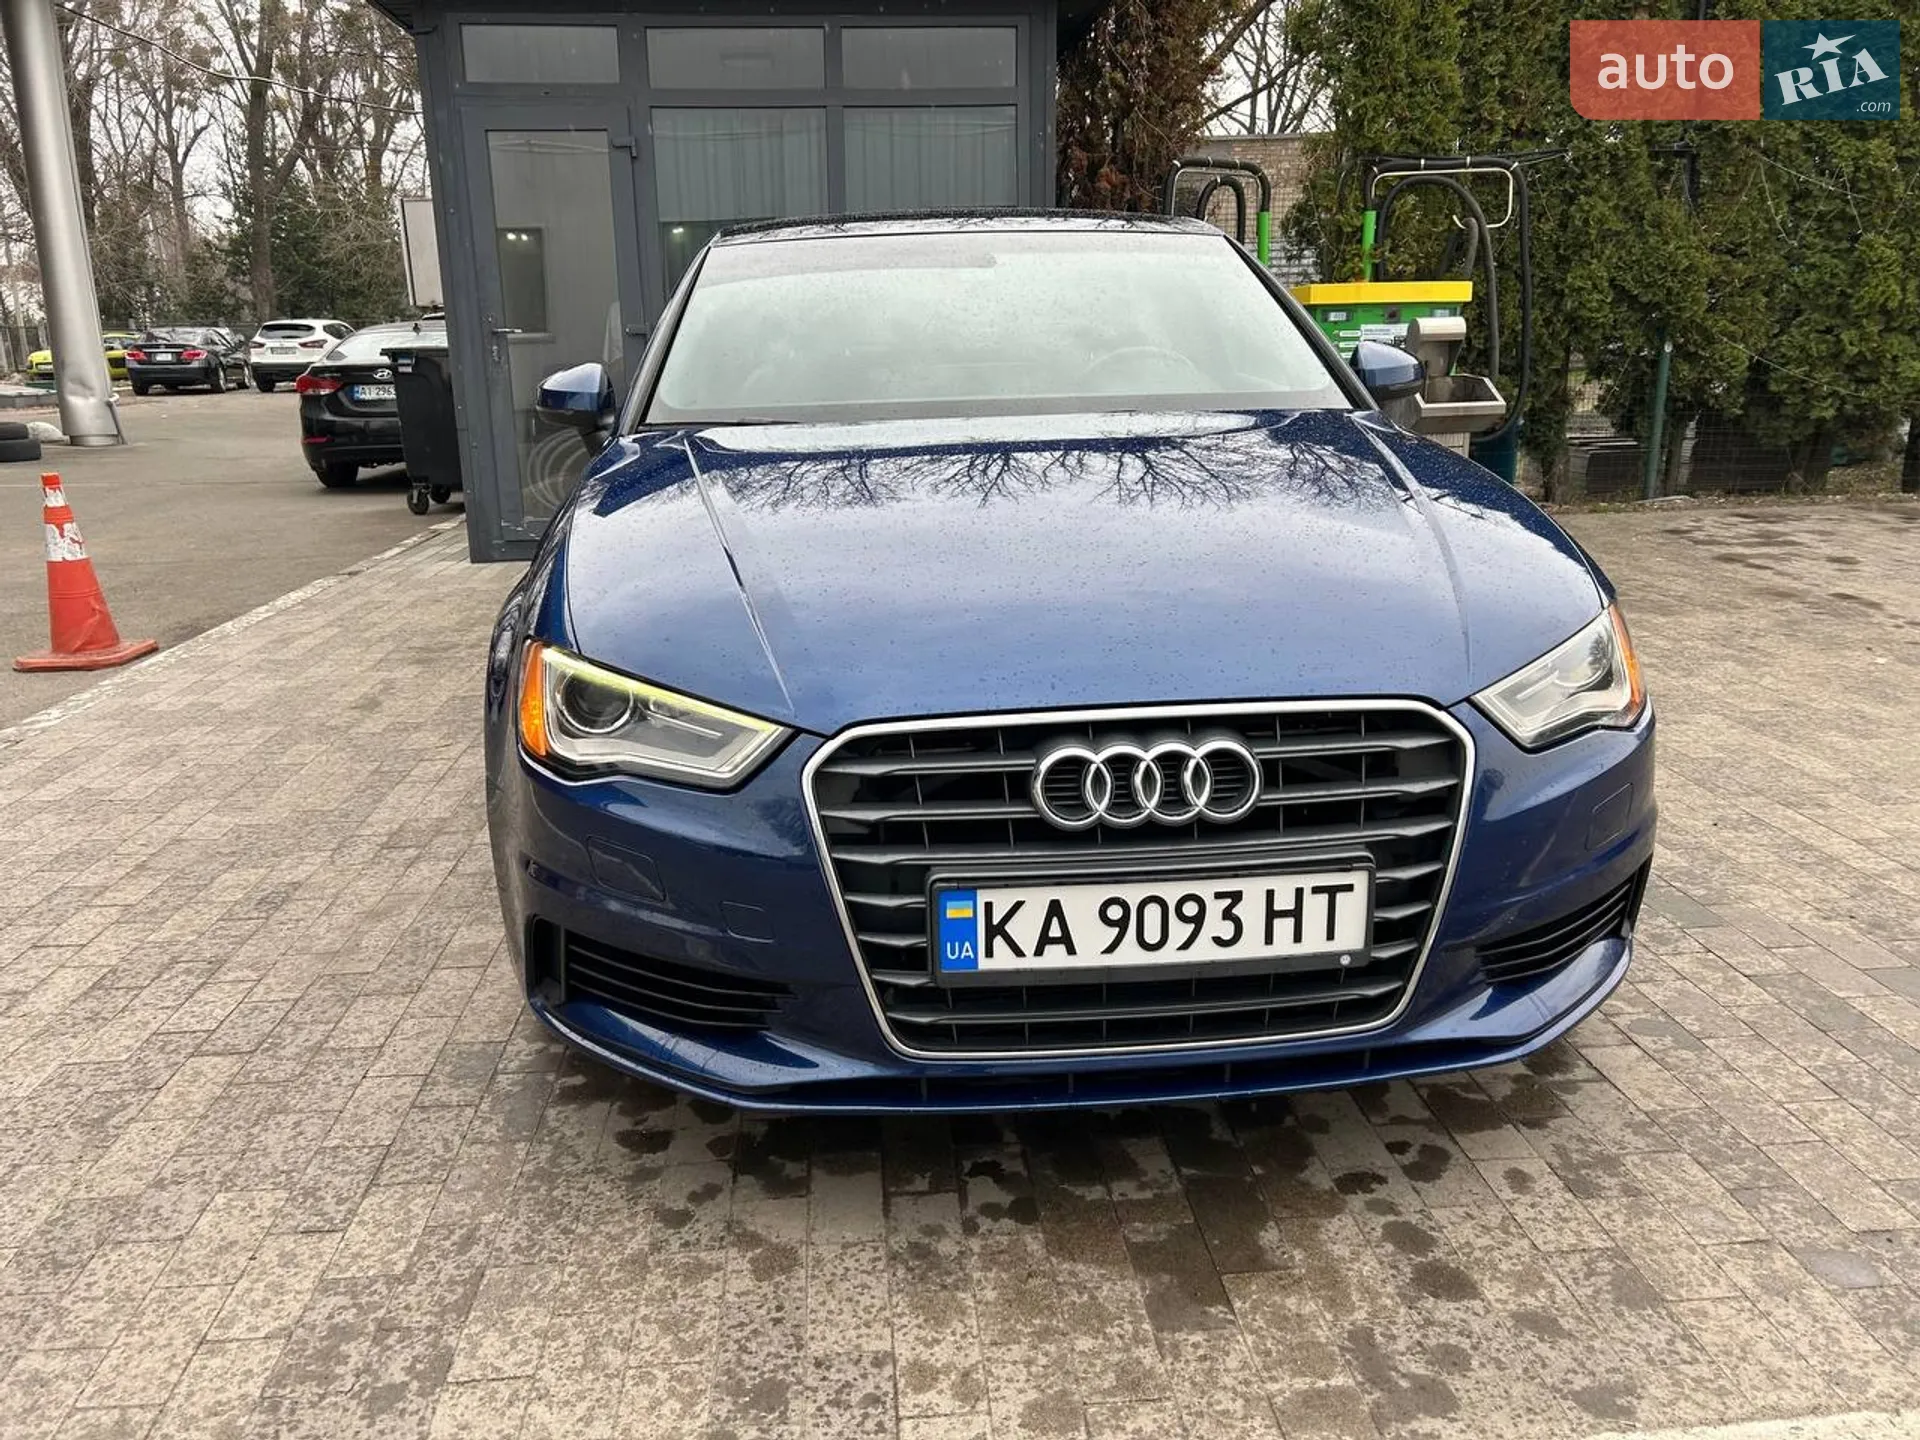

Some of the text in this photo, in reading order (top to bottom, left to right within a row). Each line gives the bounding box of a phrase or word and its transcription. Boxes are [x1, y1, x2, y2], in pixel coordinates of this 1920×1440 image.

[984, 883, 1354, 959] KA 9093 HT
[945, 942, 975, 960] UA
